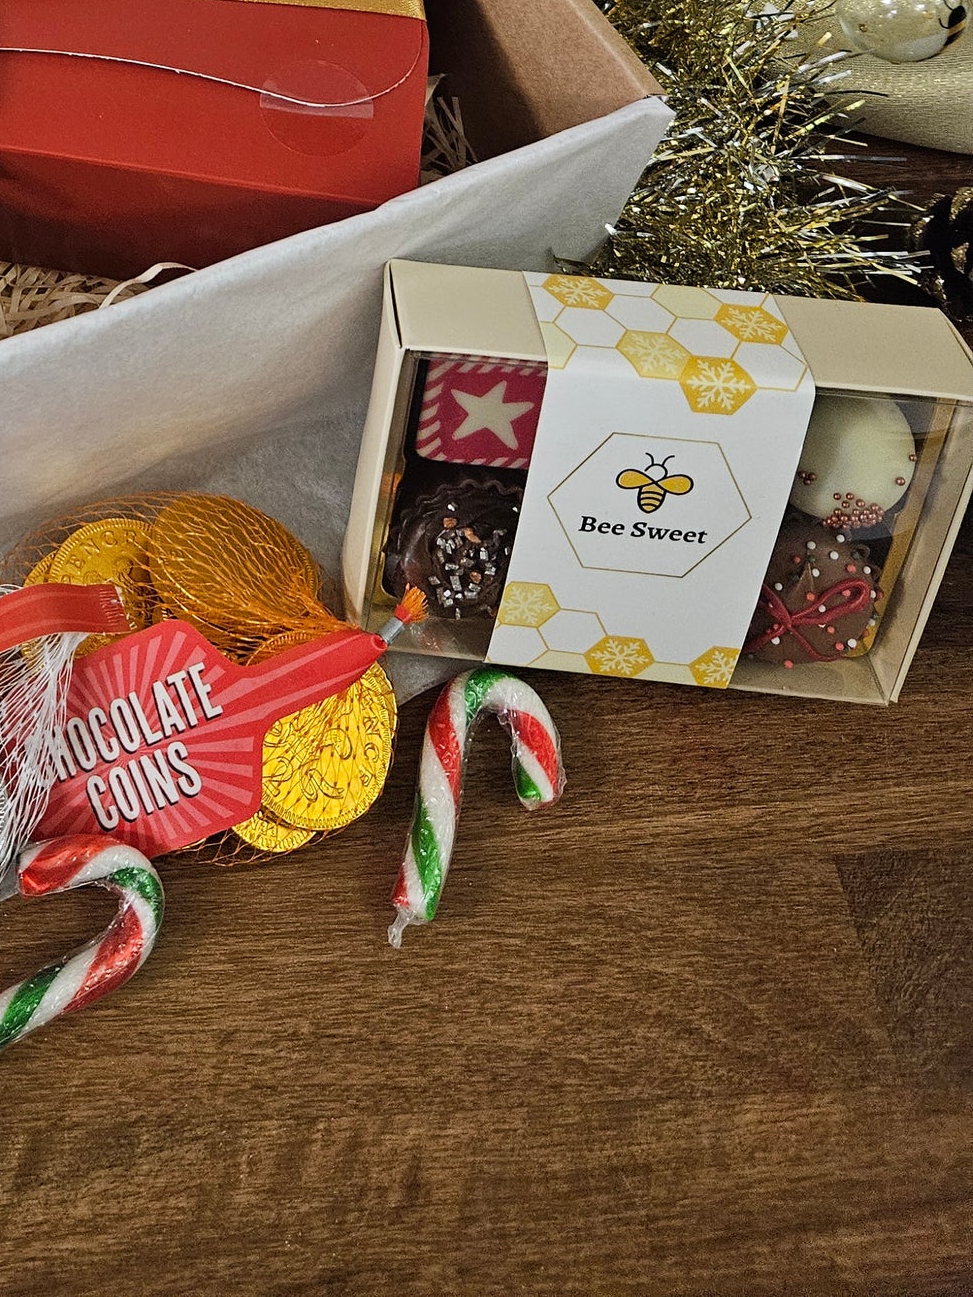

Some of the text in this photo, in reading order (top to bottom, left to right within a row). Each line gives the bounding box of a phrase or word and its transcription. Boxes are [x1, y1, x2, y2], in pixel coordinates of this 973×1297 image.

[578, 515, 708, 544] Bee Sweet
[49, 662, 223, 783] HOCOLATE
[86, 741, 202, 831] COINS
